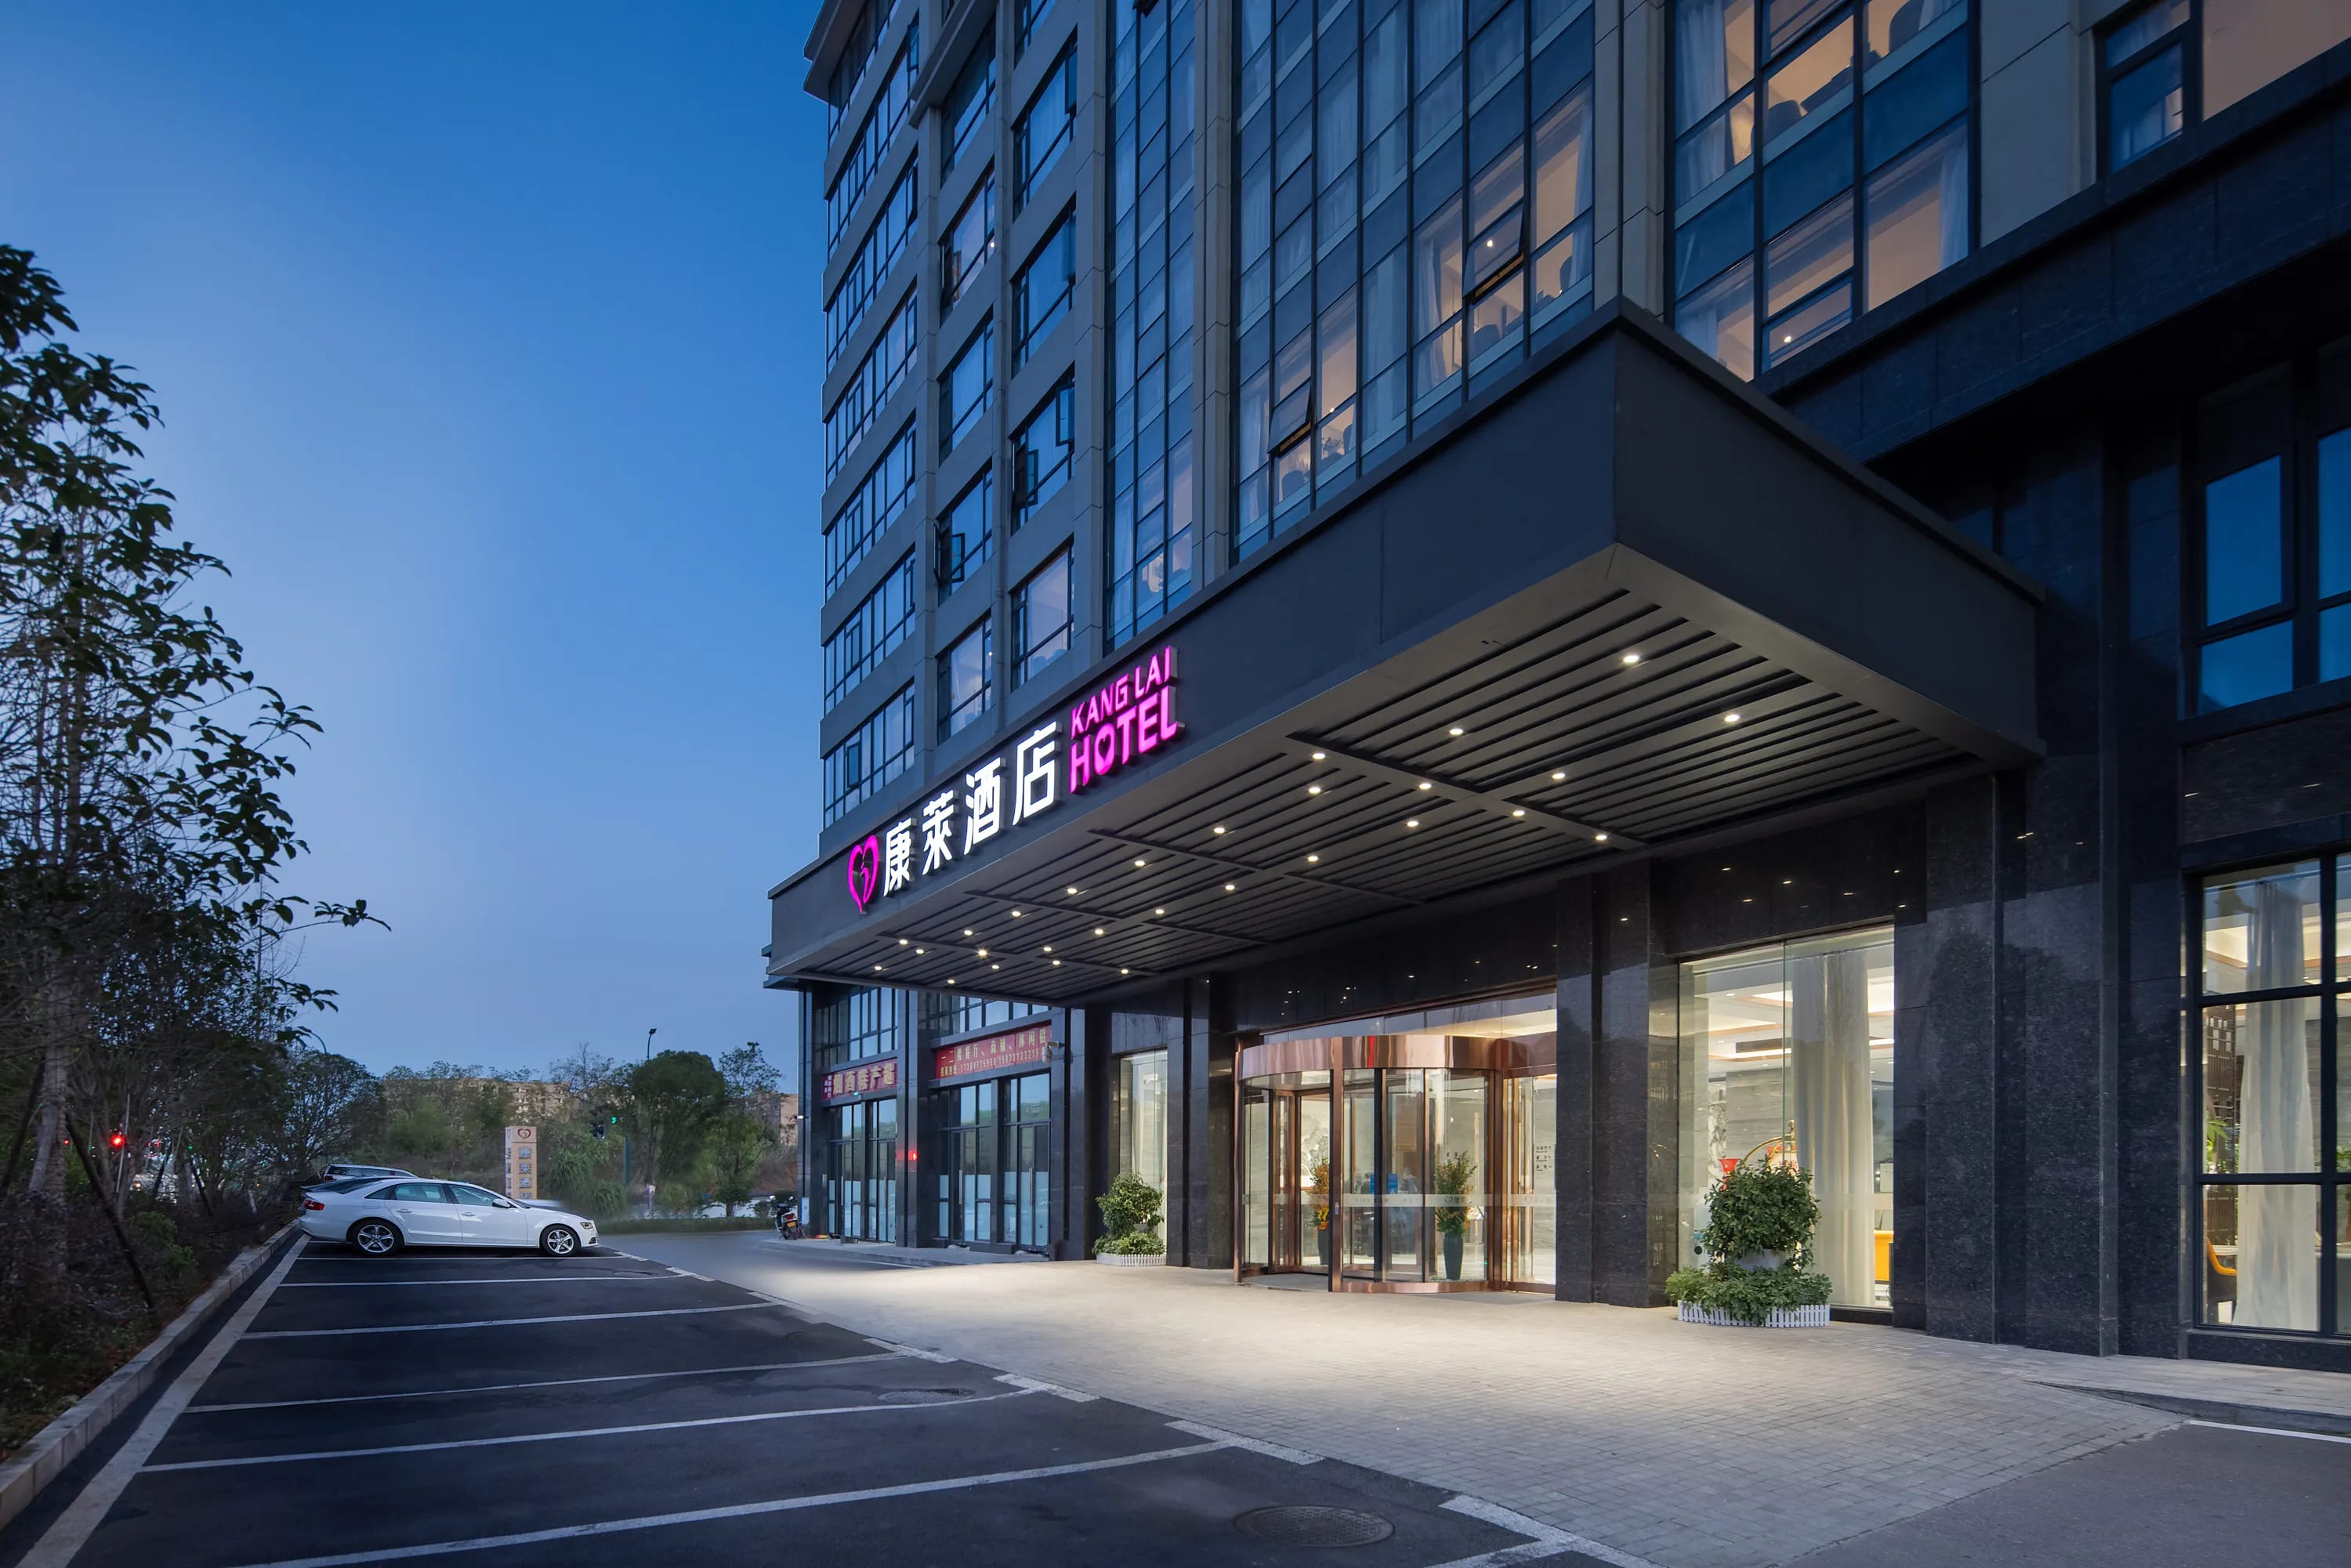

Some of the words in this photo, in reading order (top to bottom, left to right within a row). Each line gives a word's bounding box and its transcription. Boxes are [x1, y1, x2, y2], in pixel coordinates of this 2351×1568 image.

[1070, 673, 1129, 739] KANG
[1134, 646, 1172, 698] LAI
[1070, 686, 1179, 794] HOTEL
